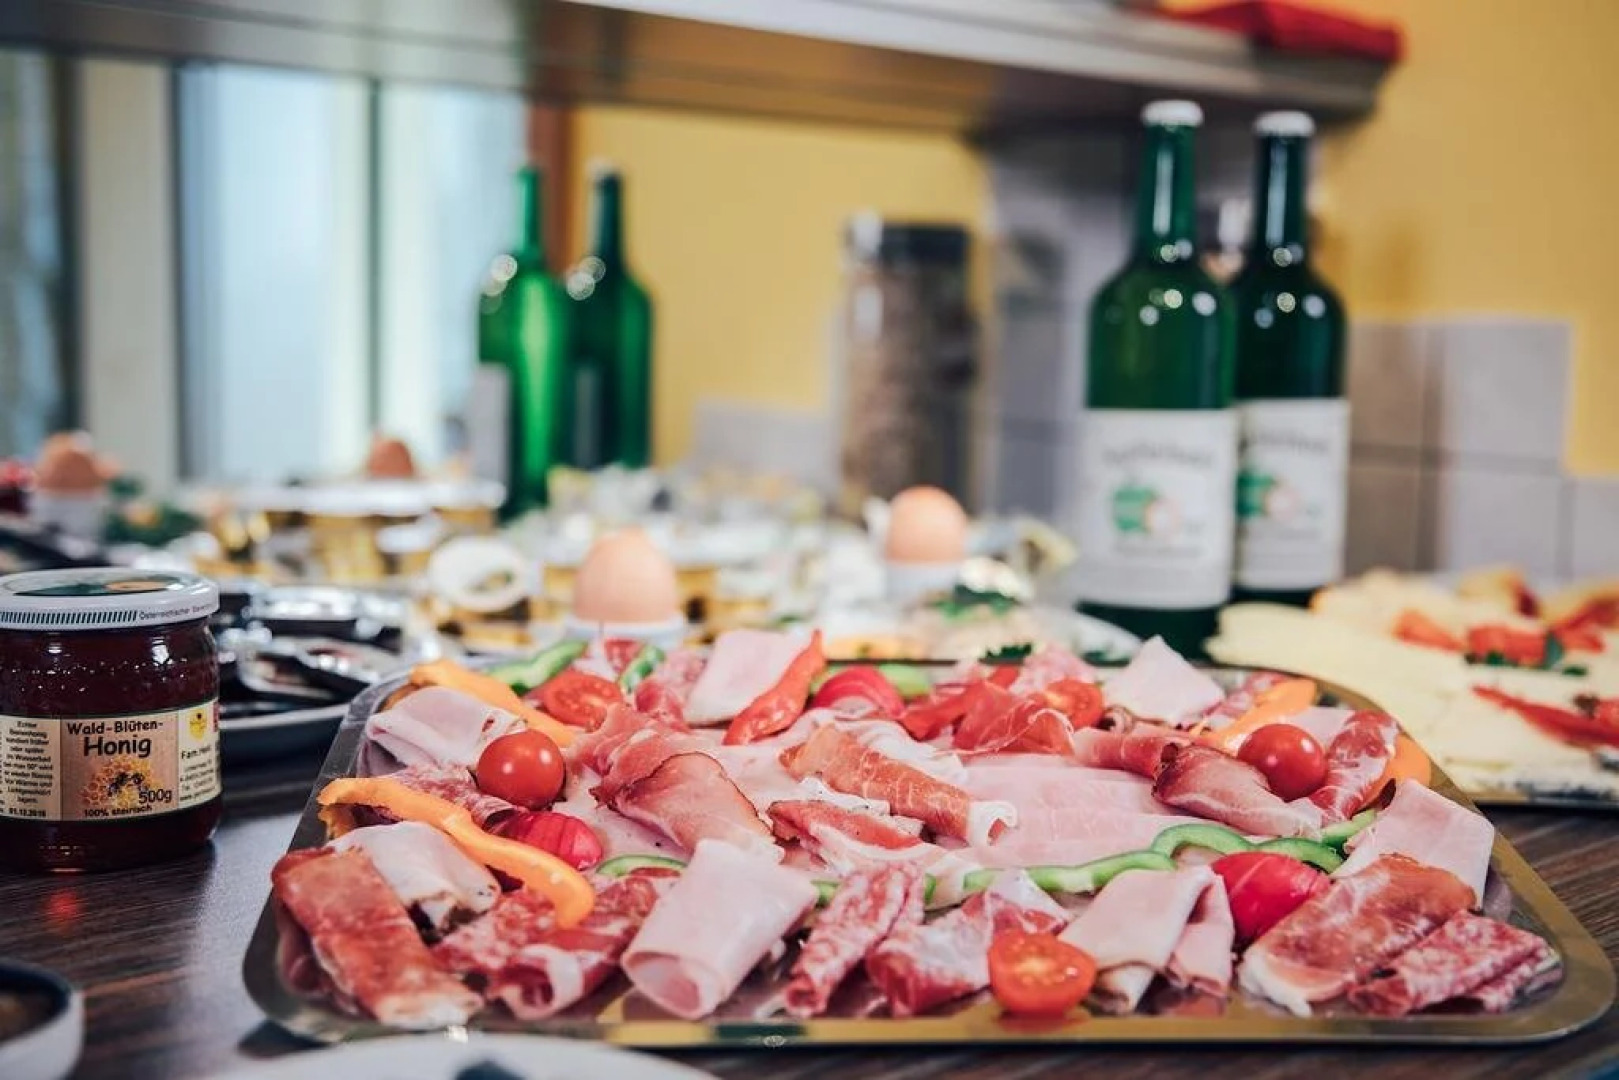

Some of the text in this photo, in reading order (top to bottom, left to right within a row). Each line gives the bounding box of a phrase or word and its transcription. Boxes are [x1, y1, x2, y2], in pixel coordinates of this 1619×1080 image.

[83, 734, 152, 758] Honig
[138, 788, 173, 804] 500g
[84, 808, 109, 817] 100%
